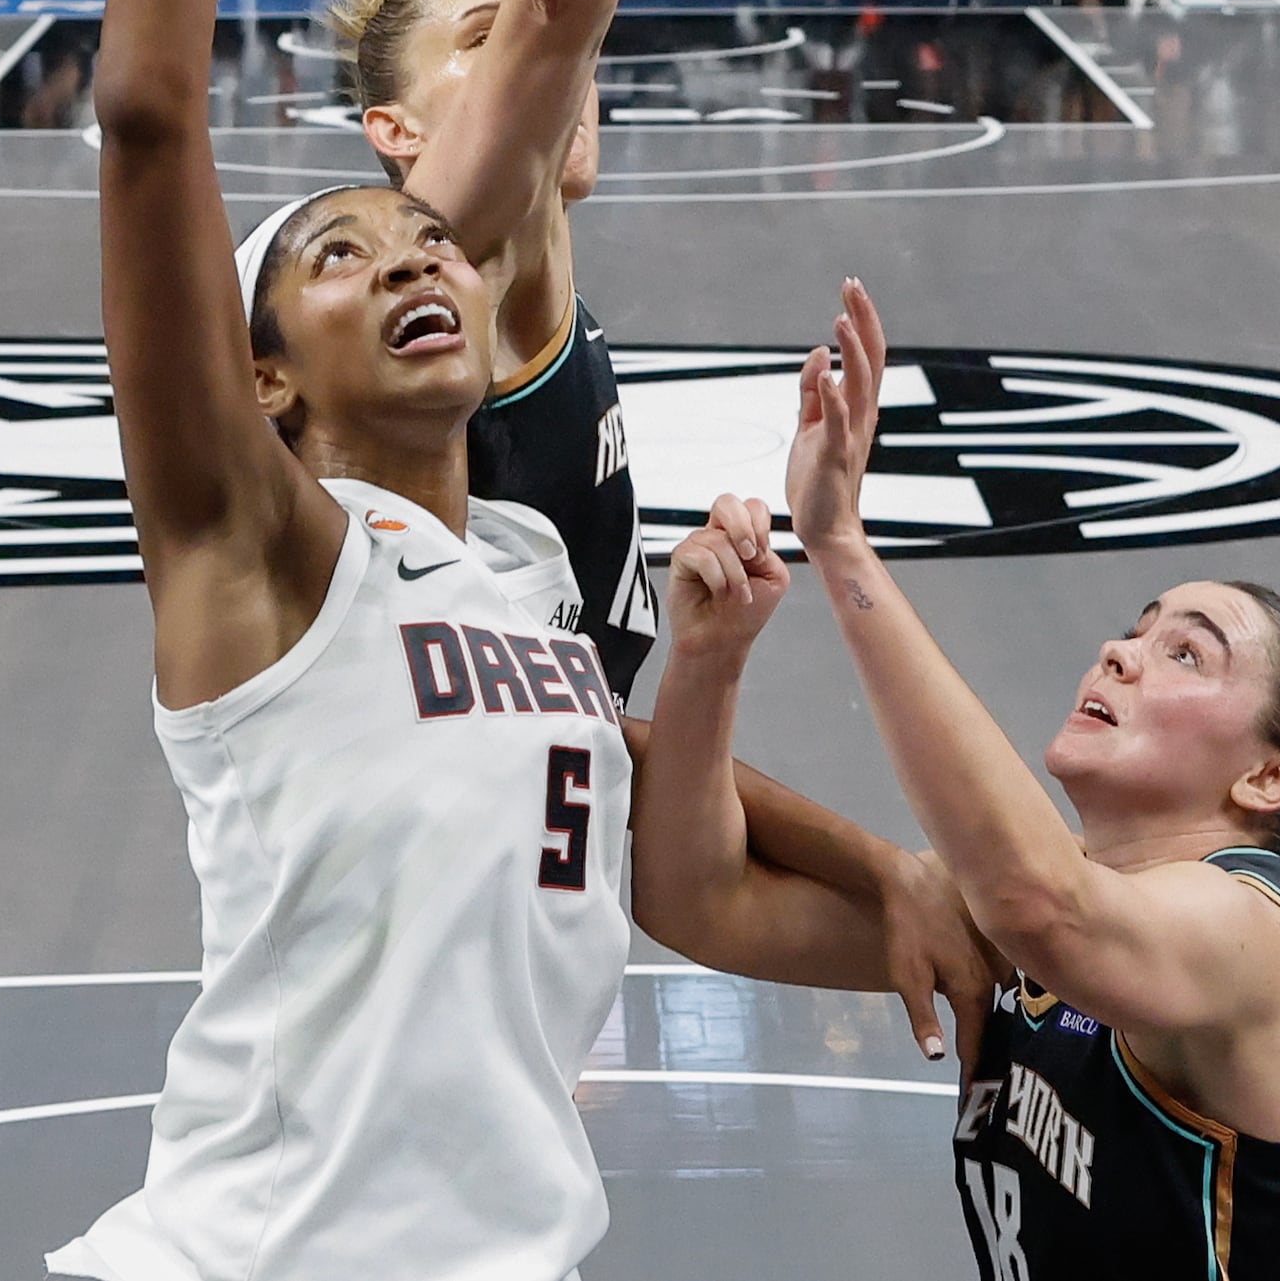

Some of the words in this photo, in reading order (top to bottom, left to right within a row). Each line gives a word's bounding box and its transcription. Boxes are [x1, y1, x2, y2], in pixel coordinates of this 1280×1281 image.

[399, 622, 618, 726] DREA
[538, 745, 590, 891] 5
[1006, 1061, 1095, 1210] YORK
